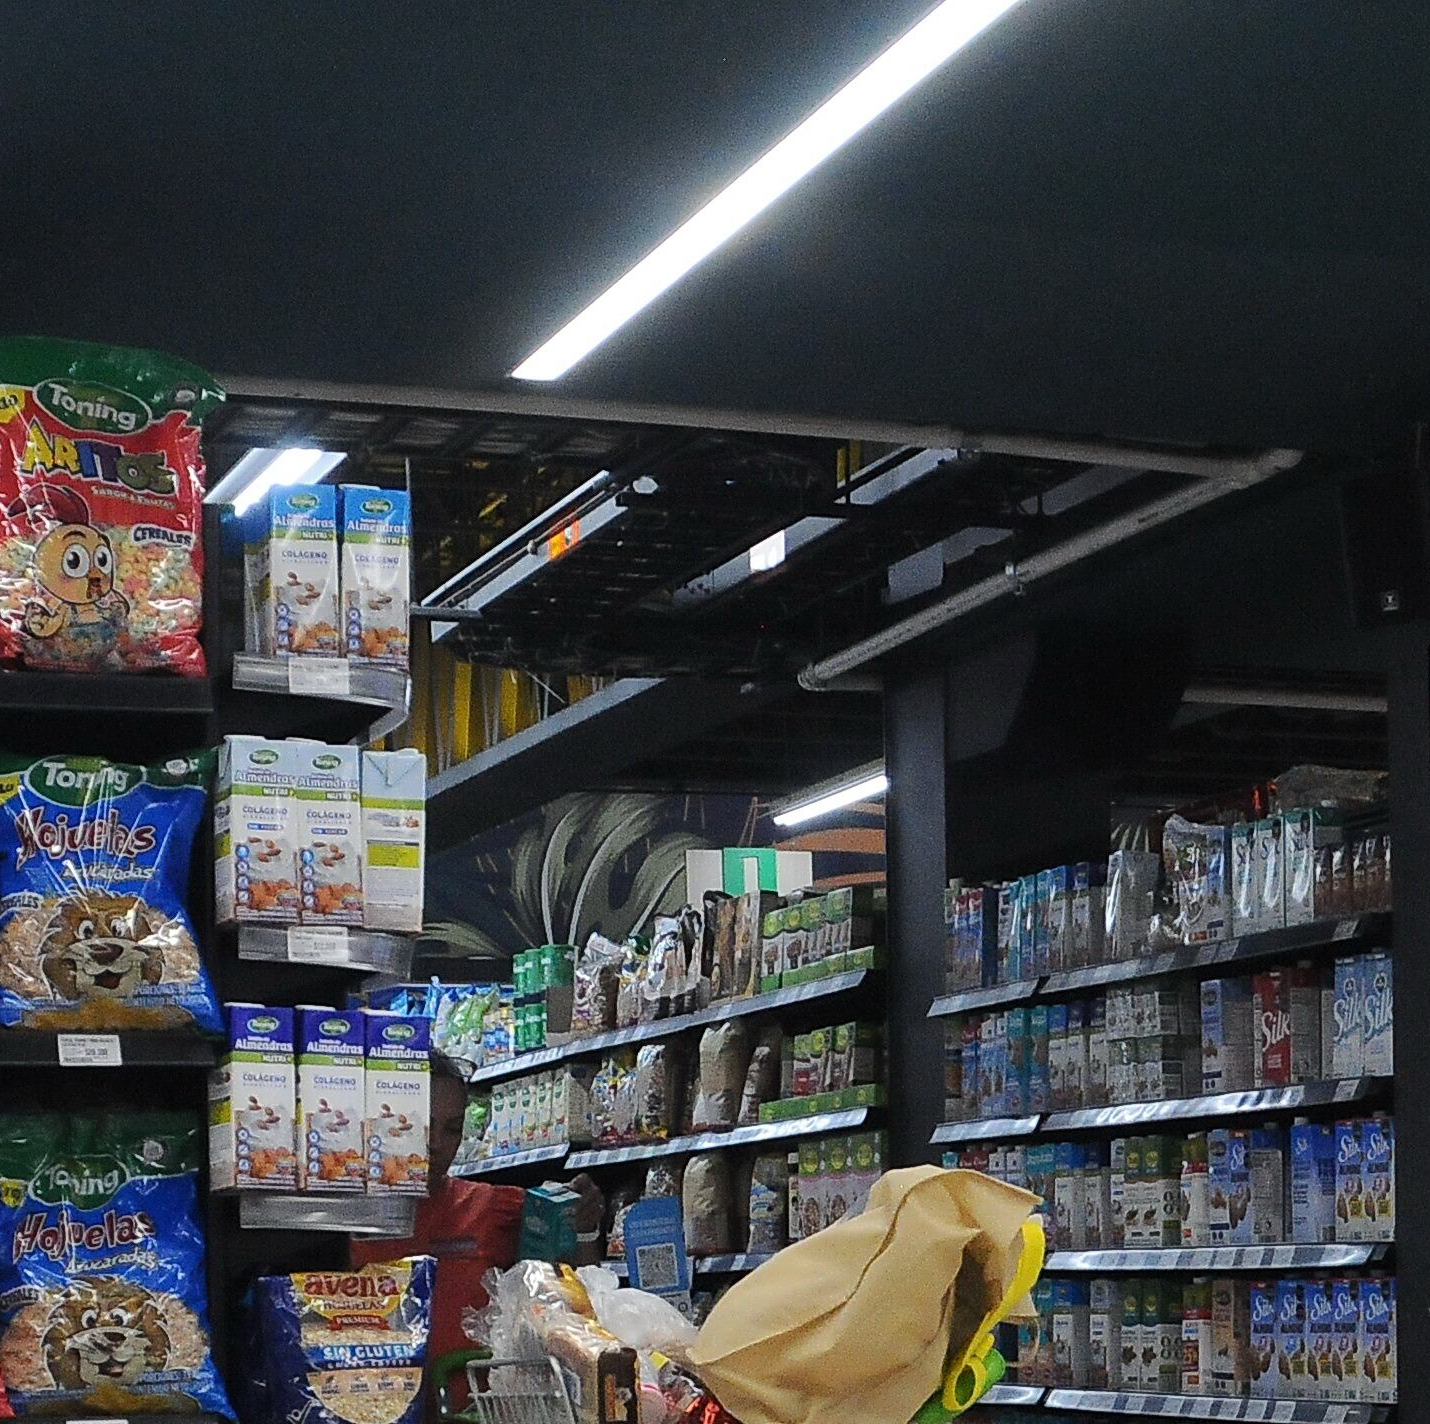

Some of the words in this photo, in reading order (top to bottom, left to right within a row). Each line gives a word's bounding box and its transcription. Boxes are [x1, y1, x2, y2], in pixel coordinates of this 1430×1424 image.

[48, 383, 137, 430] Toning
[22, 418, 180, 495] ARITOS
[133, 525, 193, 547] CEREALES
[347, 519, 407, 534] Almendras
[43, 761, 129, 791] Toning
[234, 770, 295, 784] Almendras
[16, 807, 156, 870] Hojuelas
[1261, 1010, 1290, 1052] Silk
[235, 1037, 293, 1051] Almendras
[306, 1041, 364, 1054] Almendras
[369, 1046, 429, 1059] Almendras
[242, 1072, 287, 1083] COLÁGENO
[13, 1210, 156, 1264] Hojuelas
[304, 1274, 400, 1298] avena
[355, 1344, 413, 1360] GLUTEN
